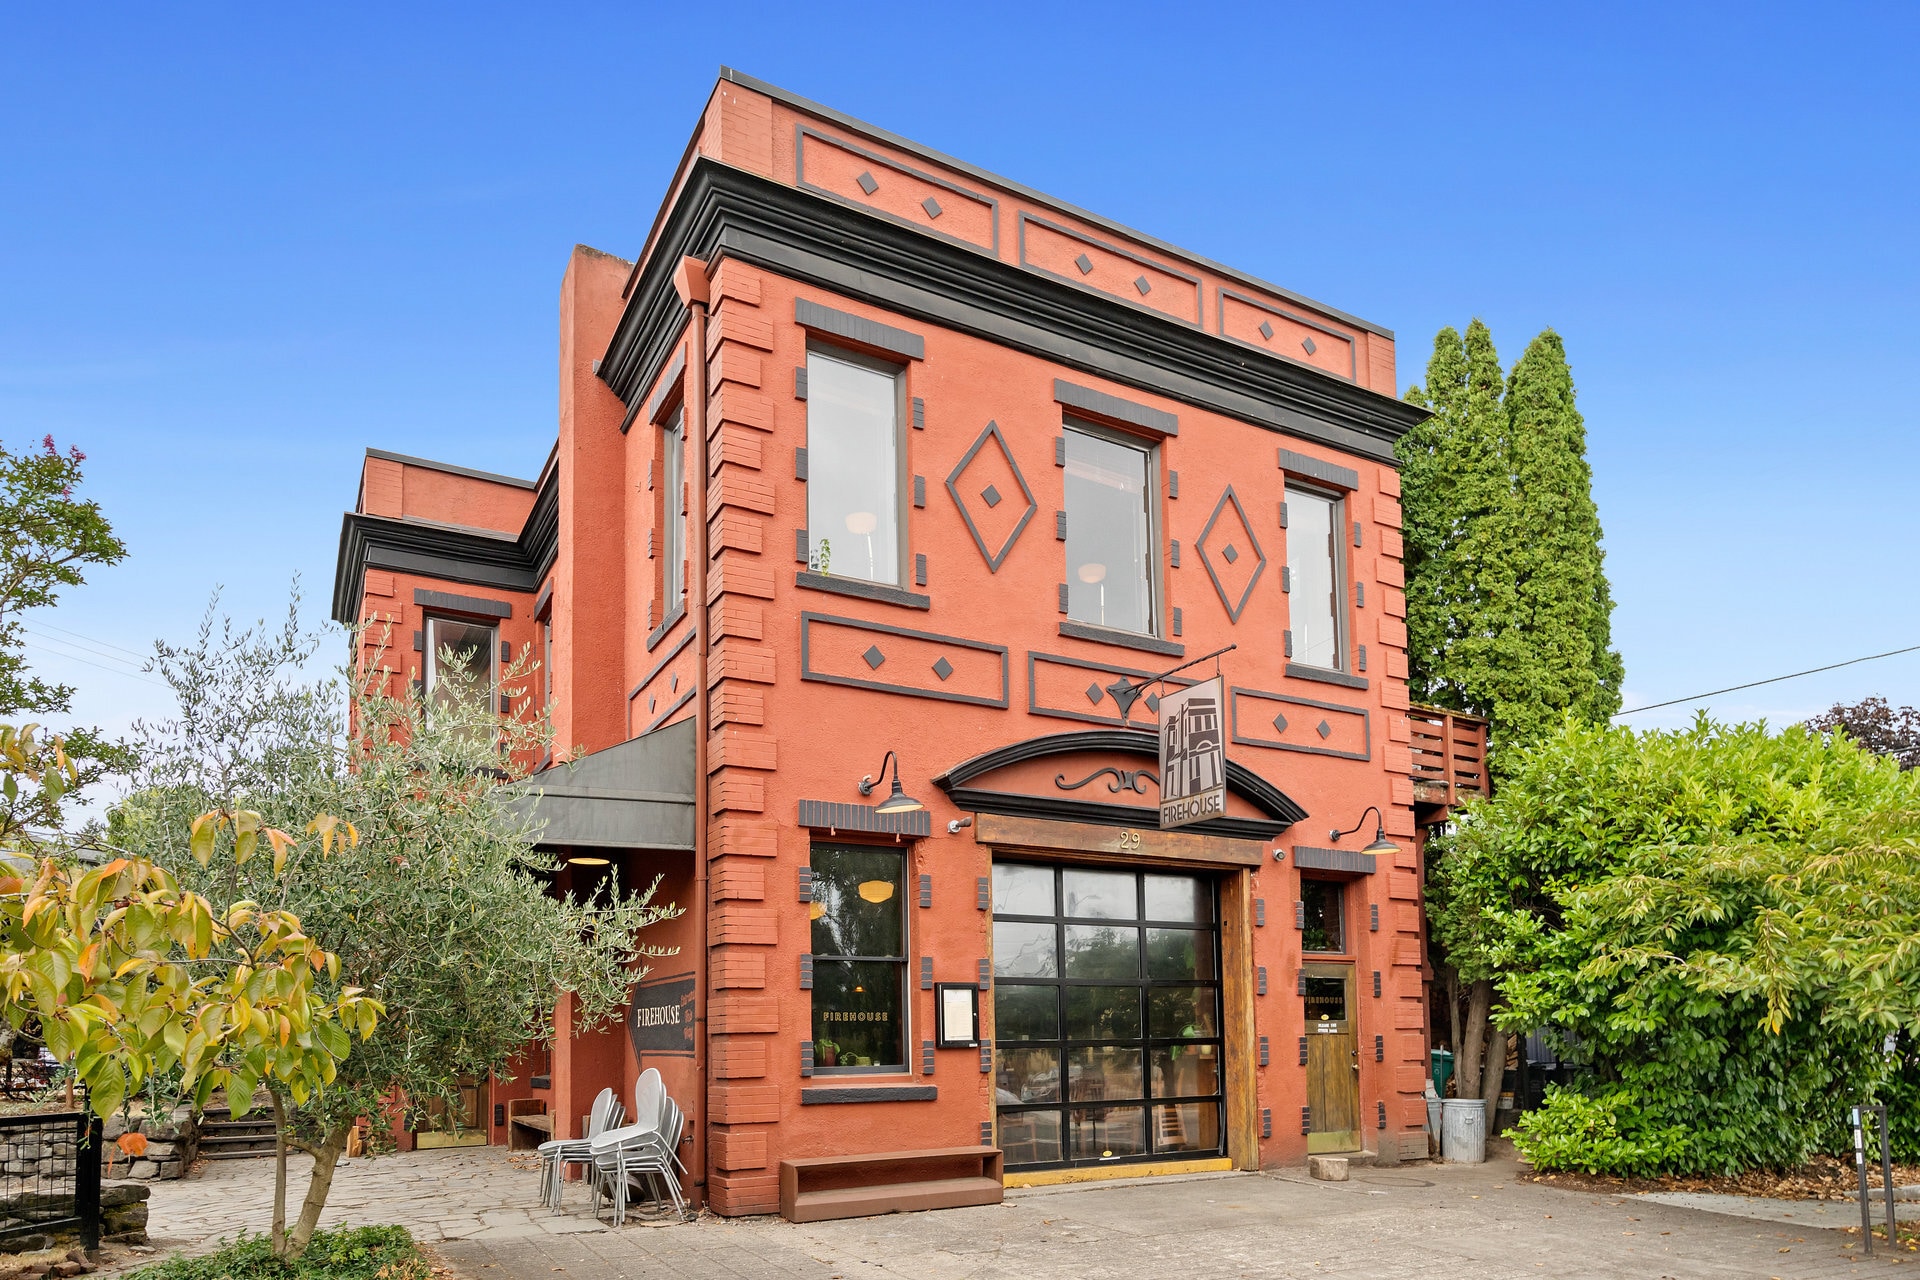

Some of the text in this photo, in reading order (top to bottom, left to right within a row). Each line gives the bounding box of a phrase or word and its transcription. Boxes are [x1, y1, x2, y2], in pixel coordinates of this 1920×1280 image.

[1163, 794, 1220, 824] FIREHOUSE
[1120, 831, 1141, 850] 29
[636, 1004, 681, 1028] FIREHOUSE
[823, 1011, 888, 1022] FIREHOUSE
